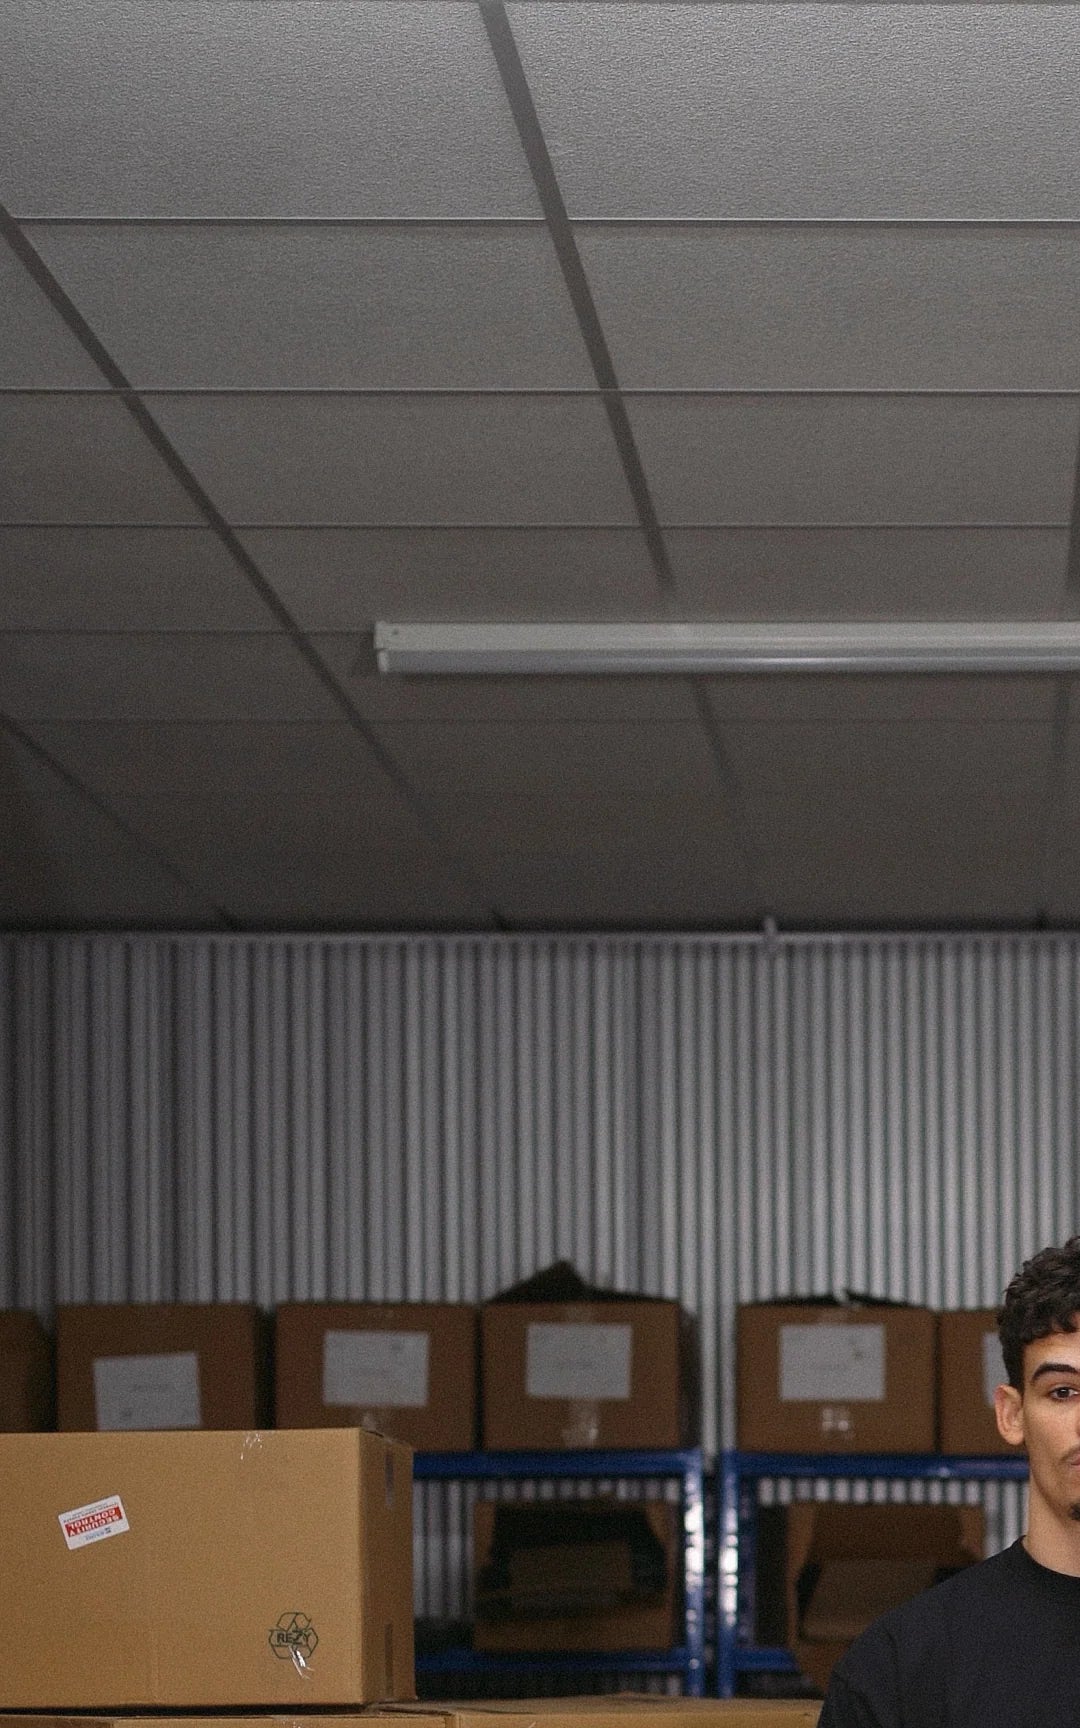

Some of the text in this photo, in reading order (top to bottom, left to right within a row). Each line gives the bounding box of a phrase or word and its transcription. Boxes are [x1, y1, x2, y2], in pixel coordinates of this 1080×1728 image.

[68, 1509, 116, 1529] CONTROL
[69, 1515, 120, 1536] SECURITY
[276, 1630, 311, 1645] REZY
